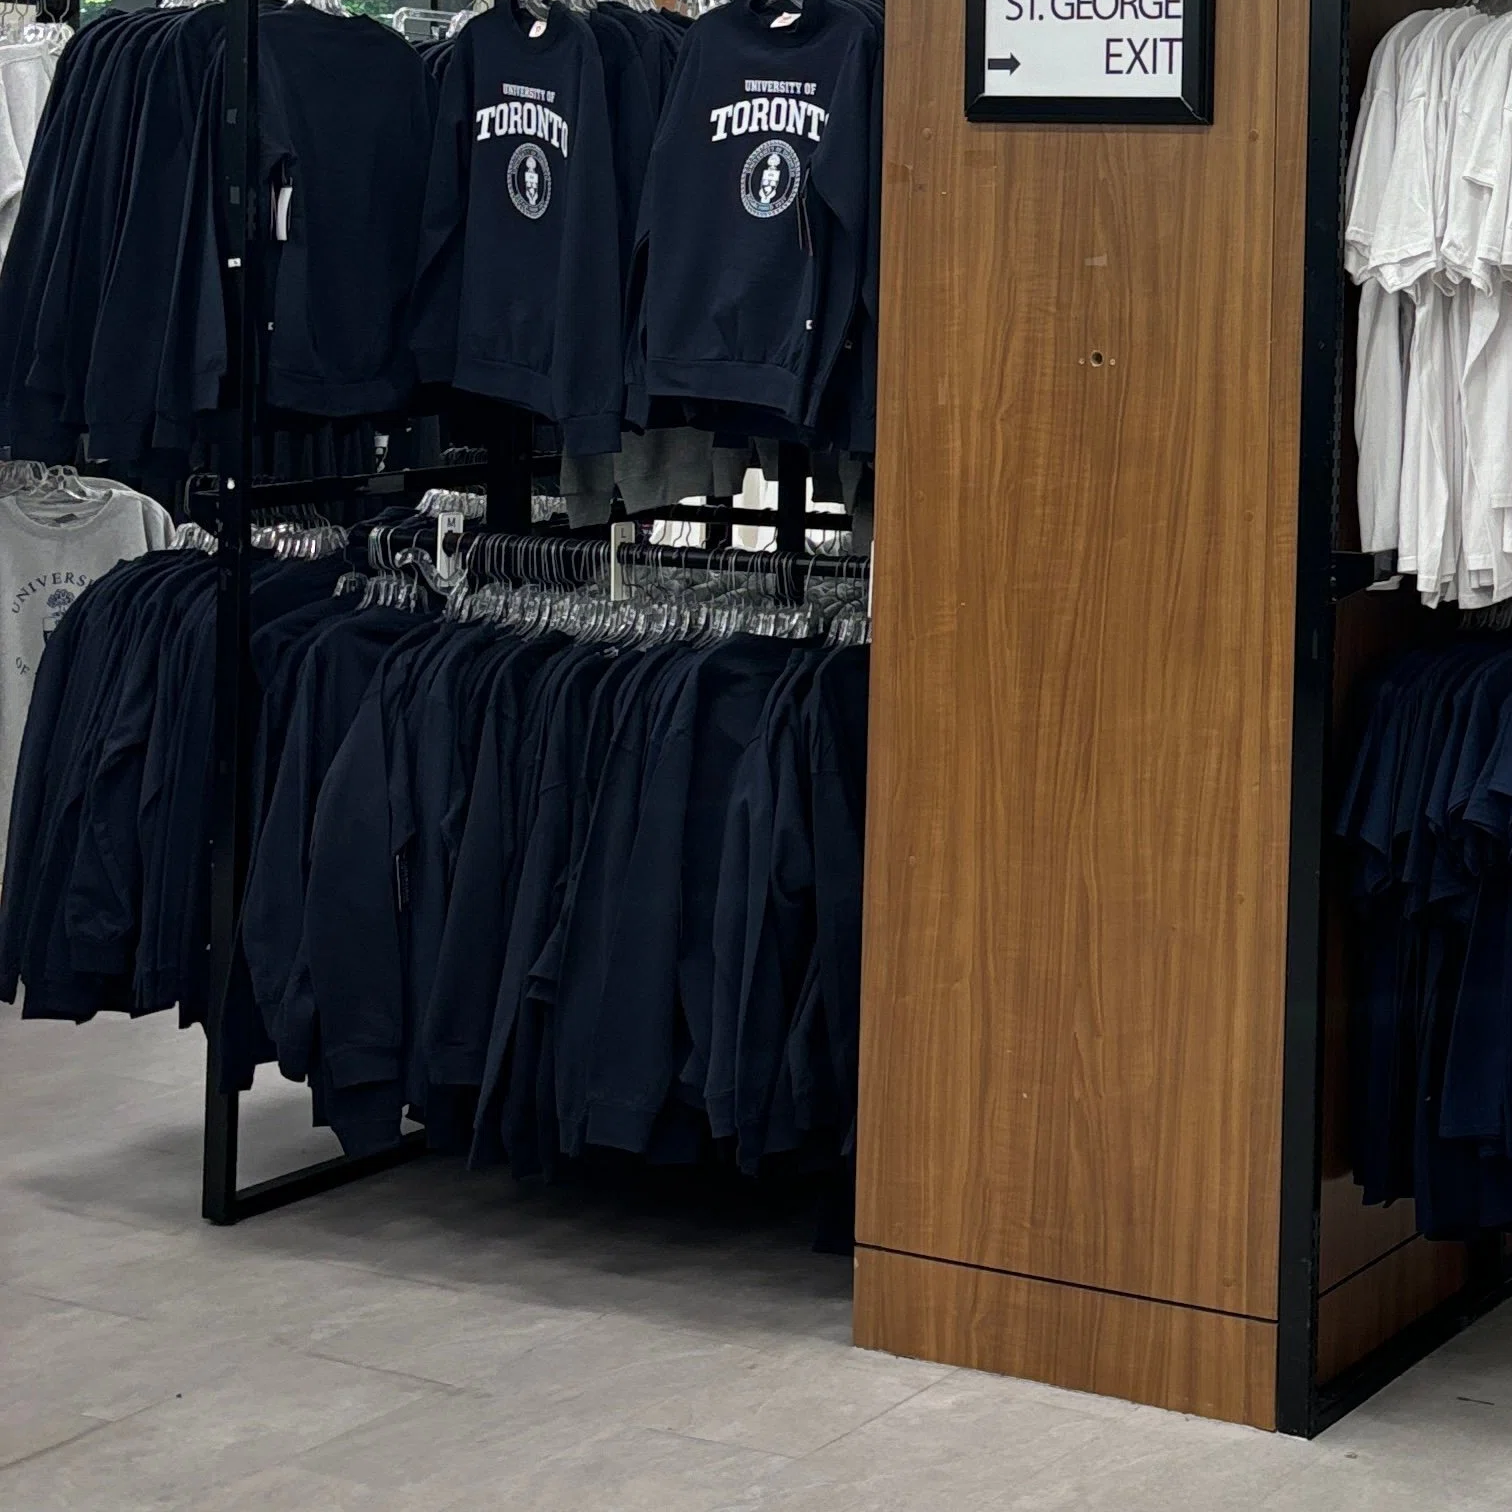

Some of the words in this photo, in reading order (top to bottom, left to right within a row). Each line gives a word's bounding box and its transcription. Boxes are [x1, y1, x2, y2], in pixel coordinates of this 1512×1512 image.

[1105, 38, 1183, 75] EXIT
[744, 80, 801, 95] UNIVERSITY
[804, 82, 817, 96] OF
[476, 101, 569, 159] TORONTO
[710, 97, 830, 142] TORONT
[12, 571, 94, 614] UNIVERSI
[16, 656, 30, 675] OF
